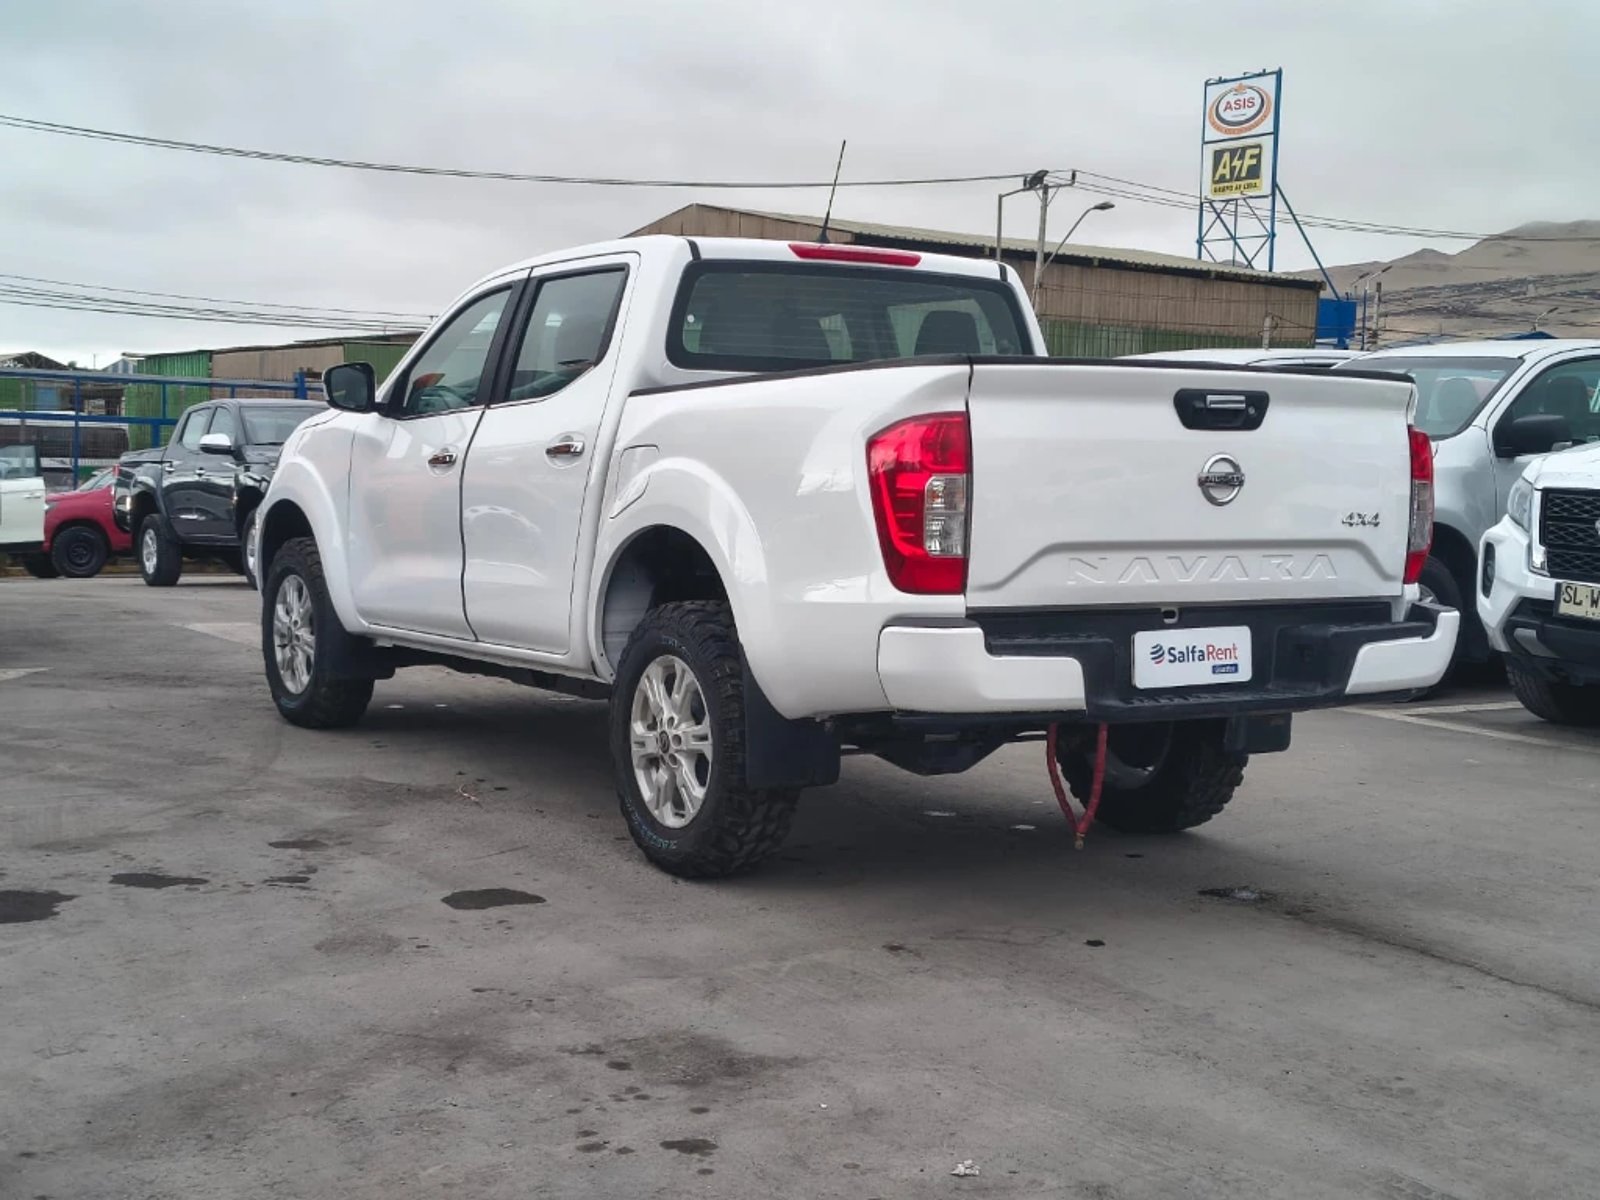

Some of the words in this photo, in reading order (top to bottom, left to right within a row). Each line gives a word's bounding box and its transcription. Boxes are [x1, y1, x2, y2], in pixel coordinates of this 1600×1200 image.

[1223, 97, 1256, 112] ASIS
[1066, 554, 1338, 584] NAVARA
[1167, 642, 1238, 663] SalfaRent
